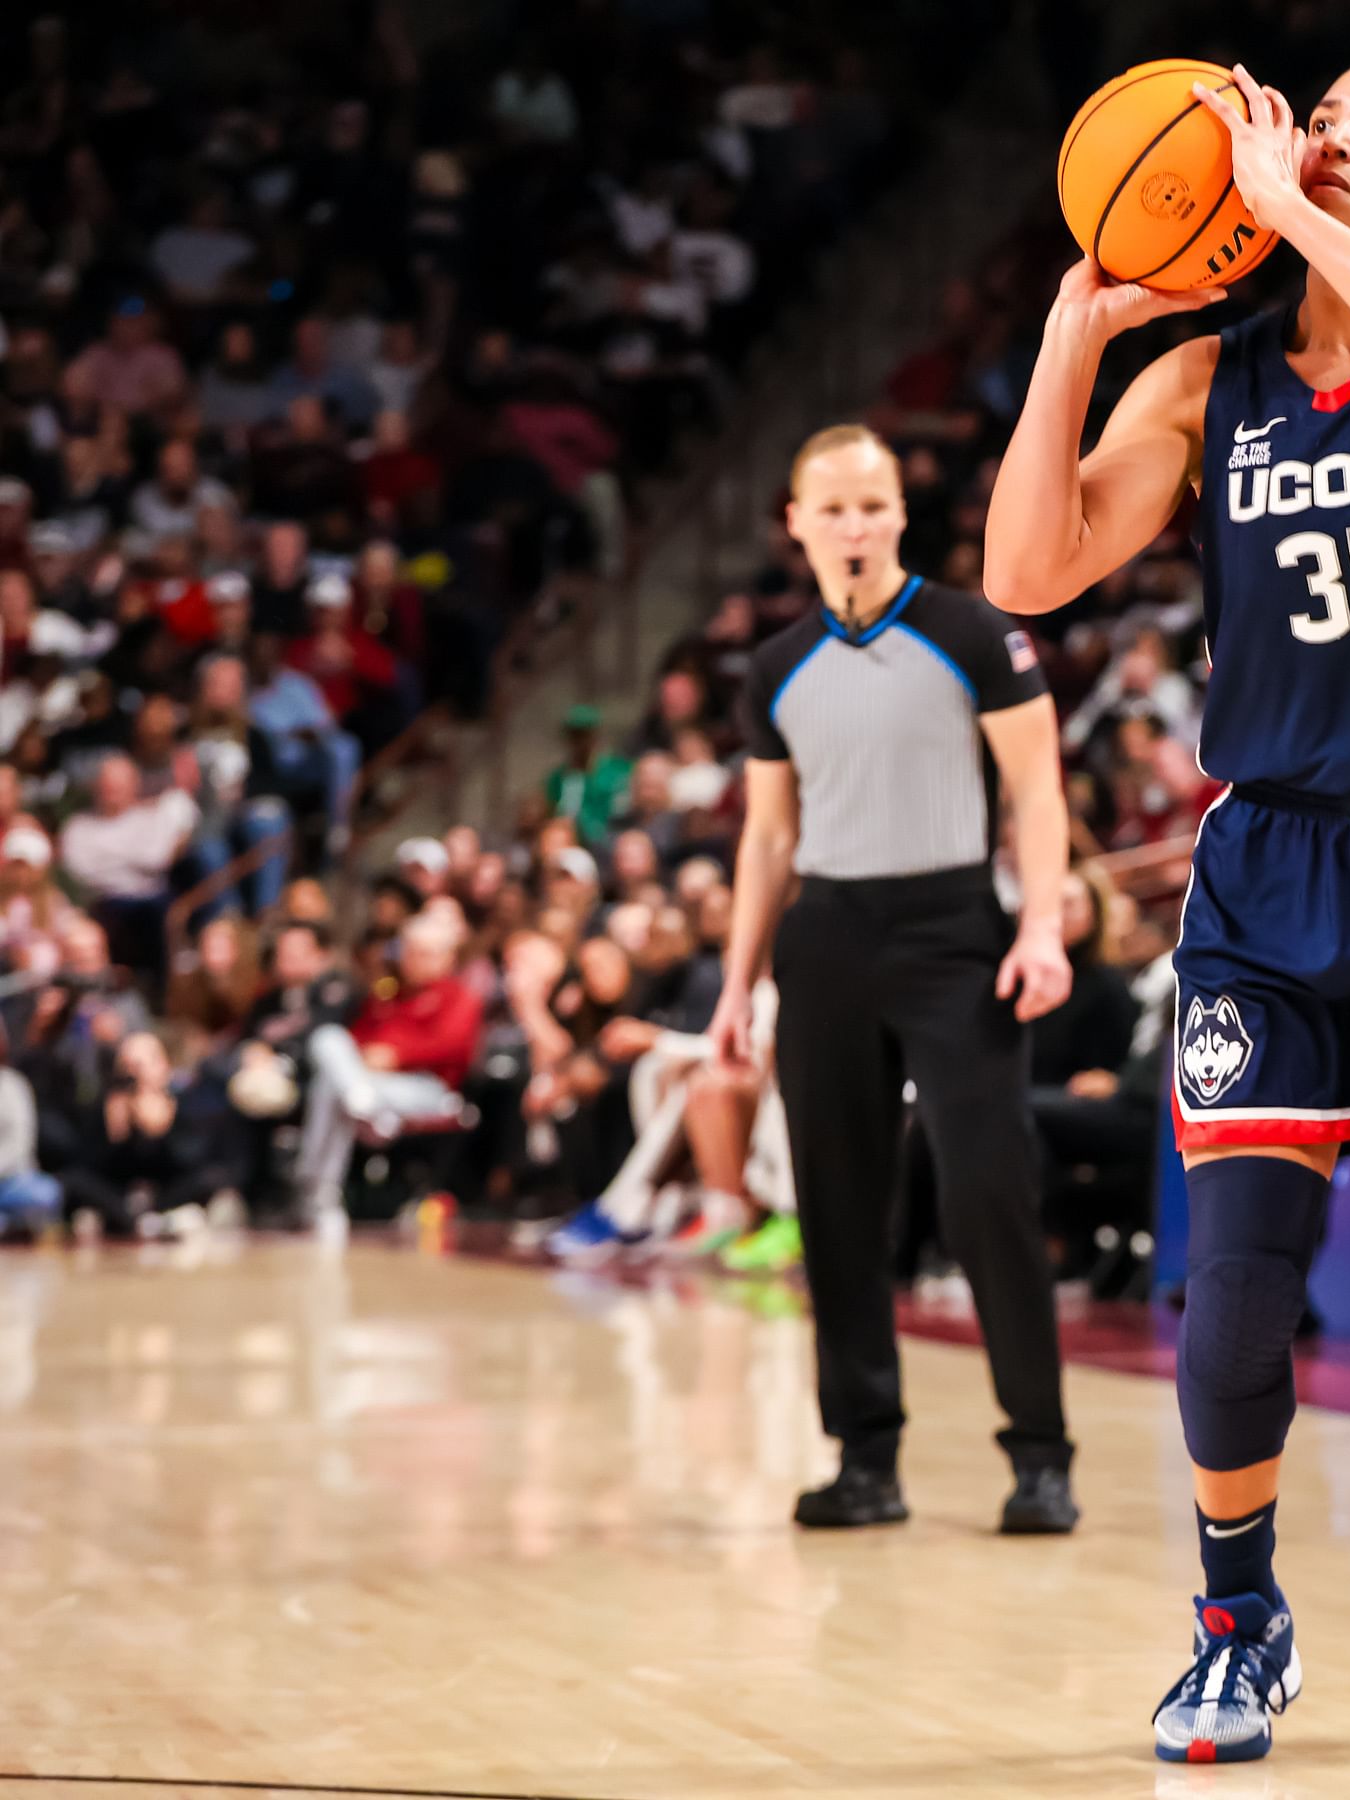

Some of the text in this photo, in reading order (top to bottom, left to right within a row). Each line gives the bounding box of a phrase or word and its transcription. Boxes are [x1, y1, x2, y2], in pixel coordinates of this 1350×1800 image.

[1206, 222, 1256, 275] VO
[1233, 441, 1272, 457] BE THE
[1228, 453, 1271, 470] CHANGE
